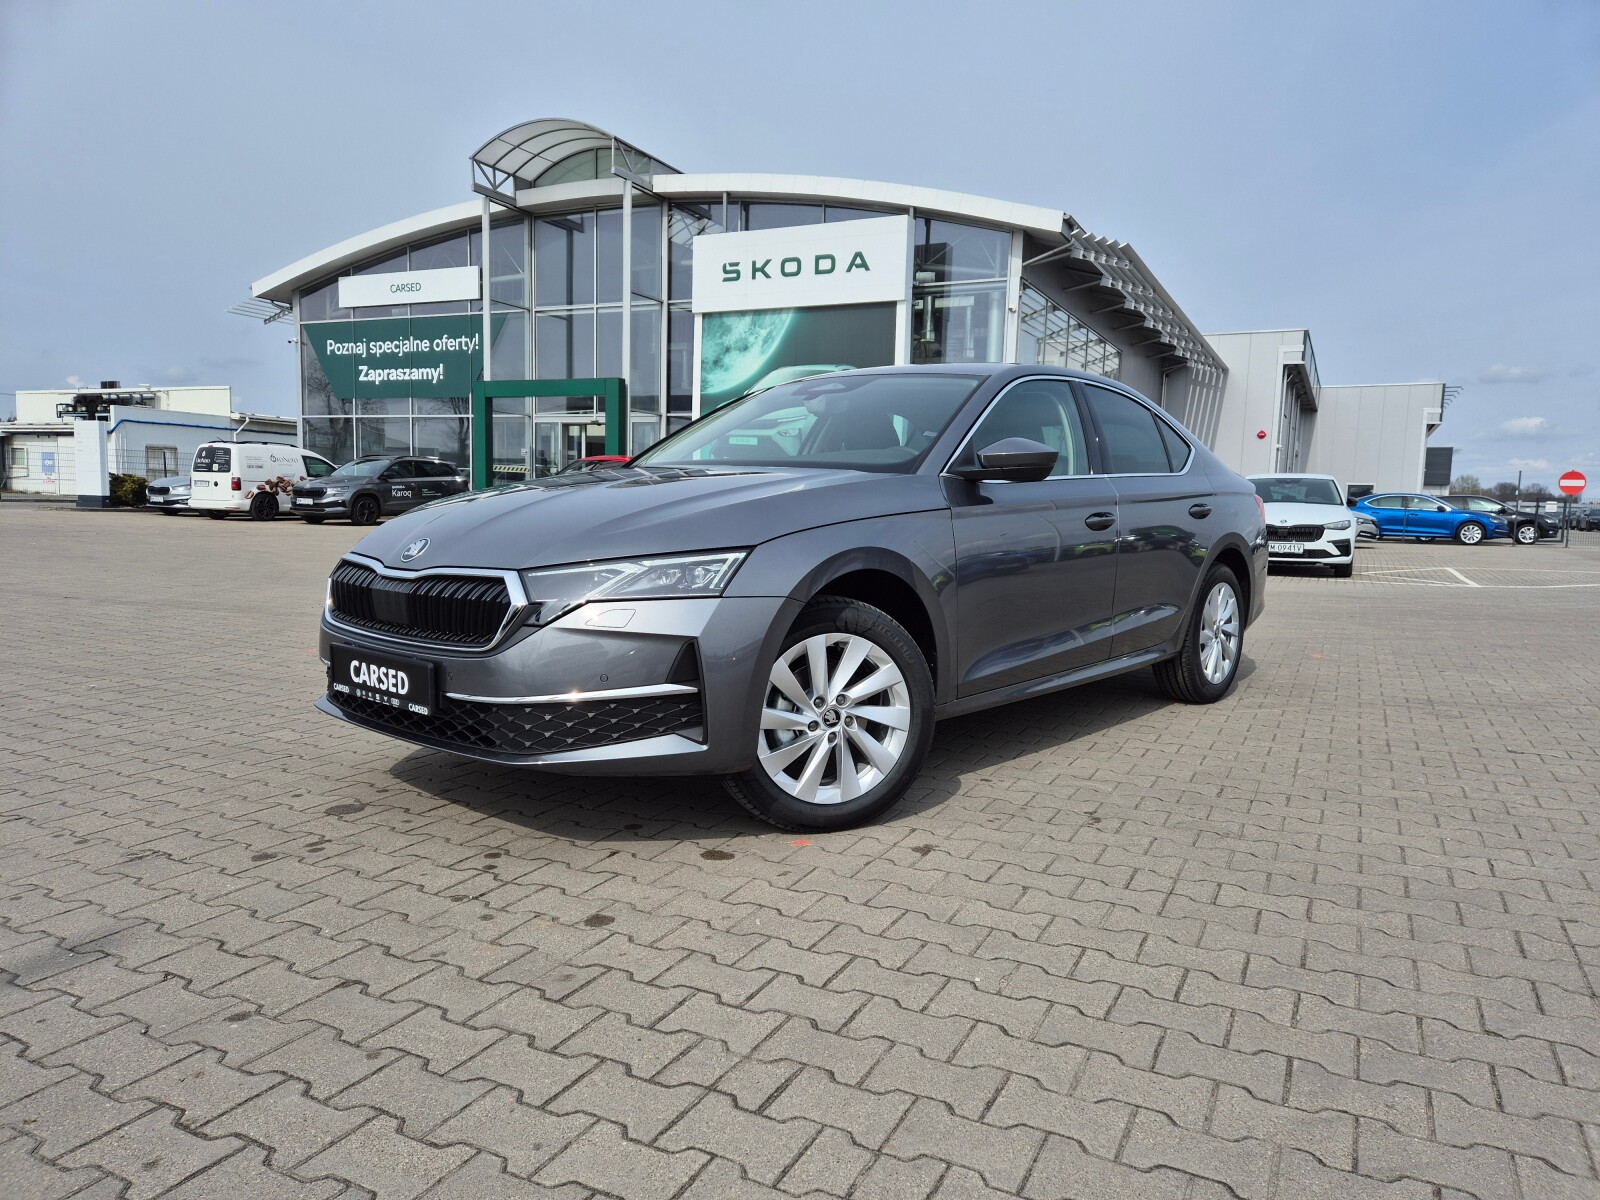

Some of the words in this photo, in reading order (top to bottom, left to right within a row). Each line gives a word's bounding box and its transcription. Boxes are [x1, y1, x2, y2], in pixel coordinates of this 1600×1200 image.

[390, 282, 421, 294] CARSED
[326, 340, 367, 358] Poznaj
[370, 336, 430, 357] specjalne
[433, 333, 479, 354] oferty!
[358, 364, 444, 385] Zapraszamy!
[391, 489, 412, 498] Karoq
[350, 659, 409, 695] CARSED
[333, 682, 350, 694] CARSED
[408, 703, 429, 715] CARSED
